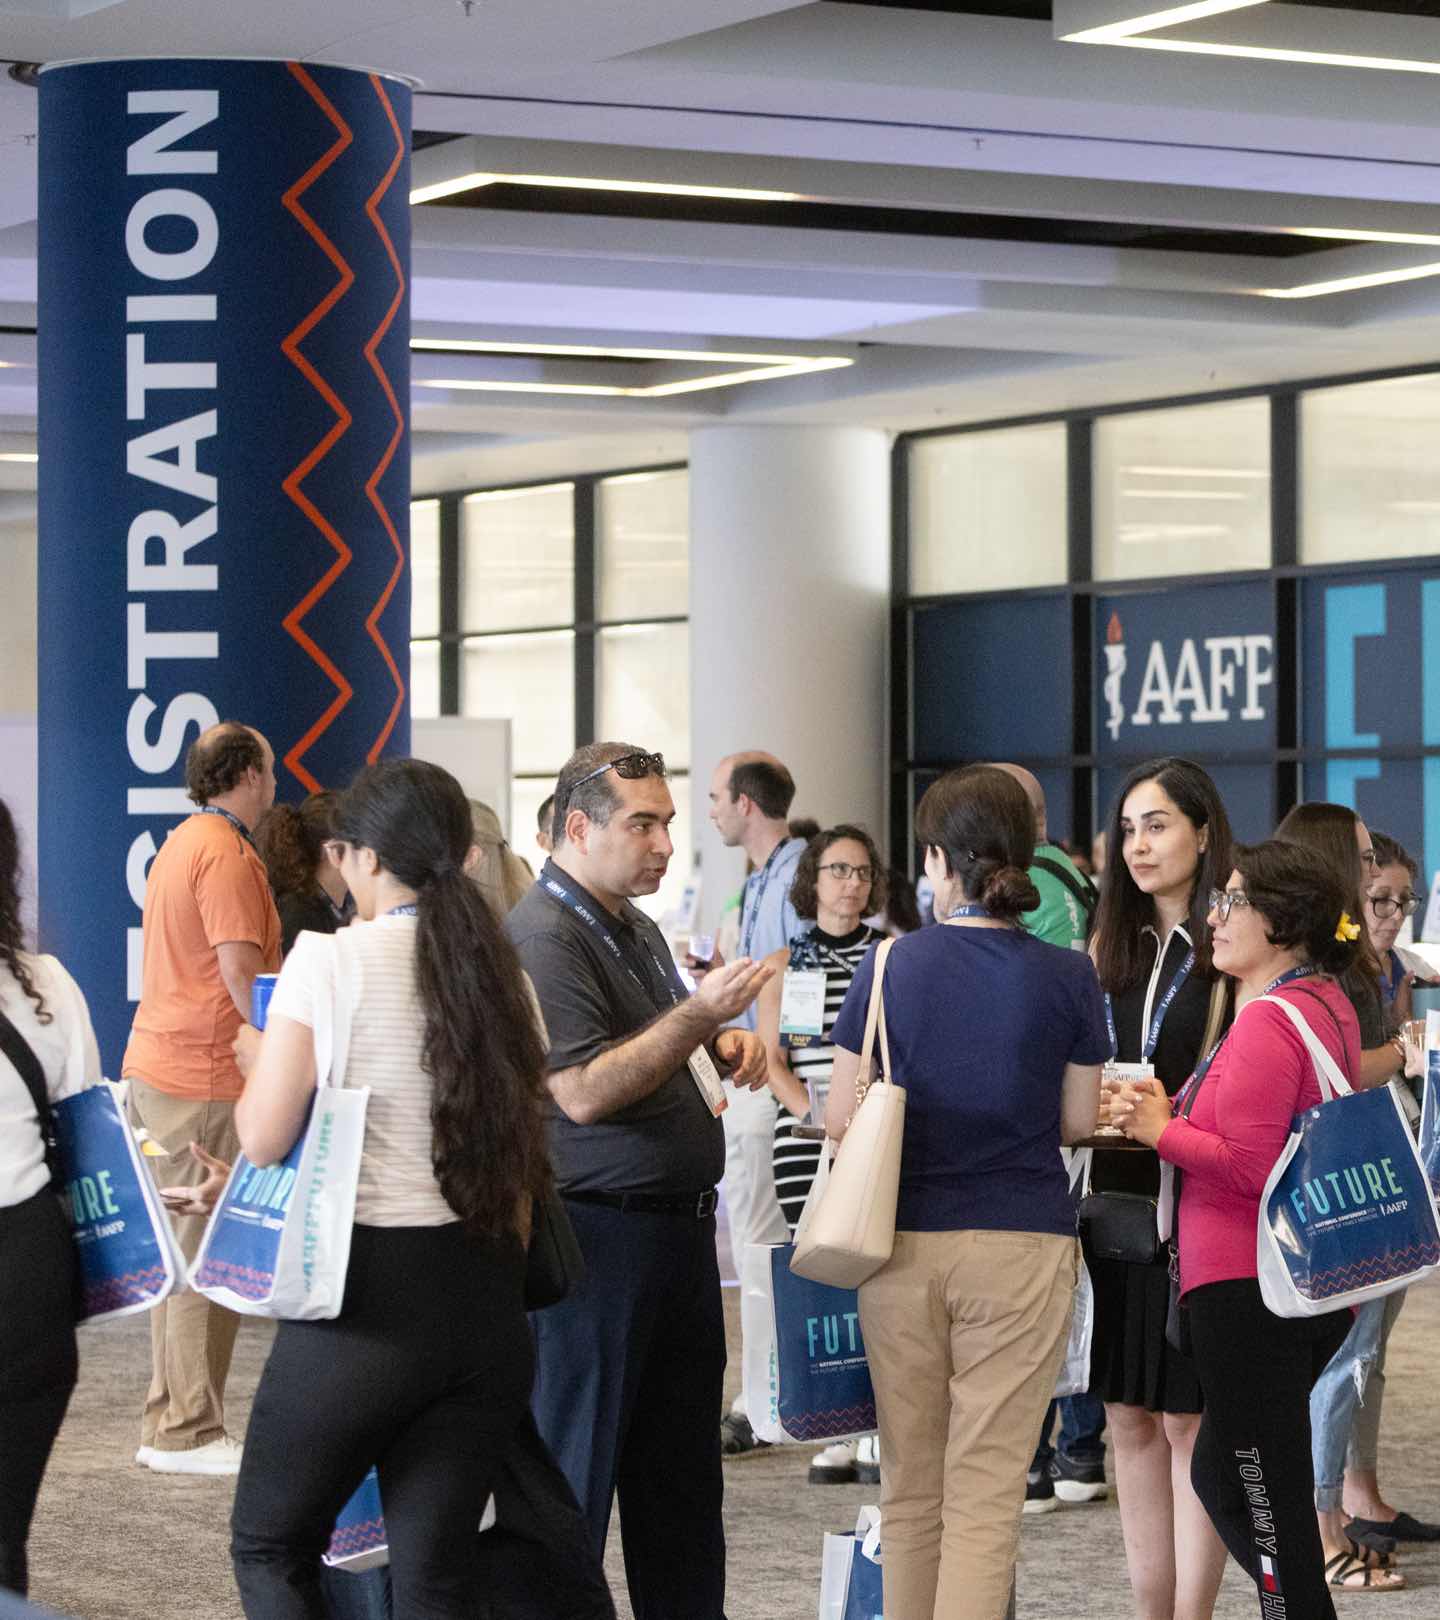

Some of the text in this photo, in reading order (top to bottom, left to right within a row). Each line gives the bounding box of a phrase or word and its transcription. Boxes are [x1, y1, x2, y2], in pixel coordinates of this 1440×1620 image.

[126, 88, 220, 1002] ISTRATION
[1290, 1158, 1403, 1224] FUTURE
[1386, 1199, 1408, 1215] AAFP
[807, 1312, 858, 1358] FUT
[1235, 1447, 1278, 1556] TOMMY
